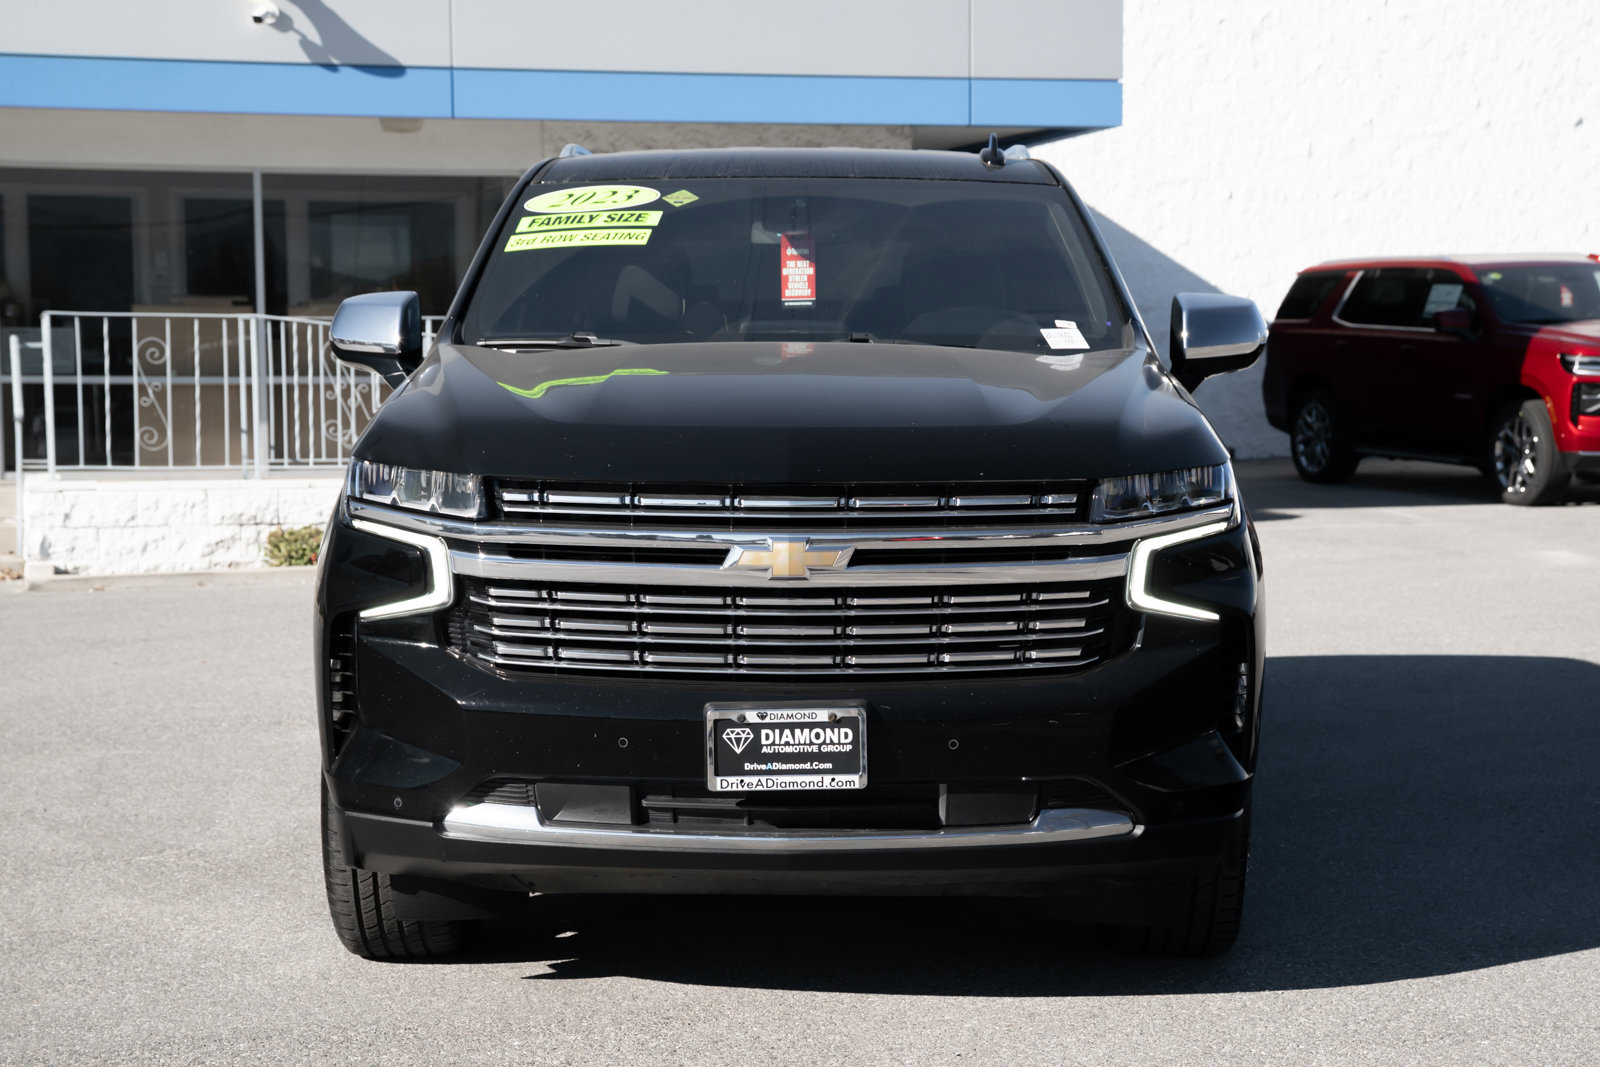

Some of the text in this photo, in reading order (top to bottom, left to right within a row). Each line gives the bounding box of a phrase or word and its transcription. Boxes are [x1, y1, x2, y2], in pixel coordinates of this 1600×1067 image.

[546, 189, 640, 208] 2023
[527, 212, 649, 229] FAMILY SIZE
[510, 231, 647, 248] 3rd ROW SEATING
[769, 711, 818, 721] DIAMOND
[760, 727, 853, 745] DIAMOND
[761, 744, 853, 753] AUTOMOTIVE GROUP
[744, 762, 833, 771] DriveADiamond.Com
[720, 776, 856, 790] DriveADiamond.com
